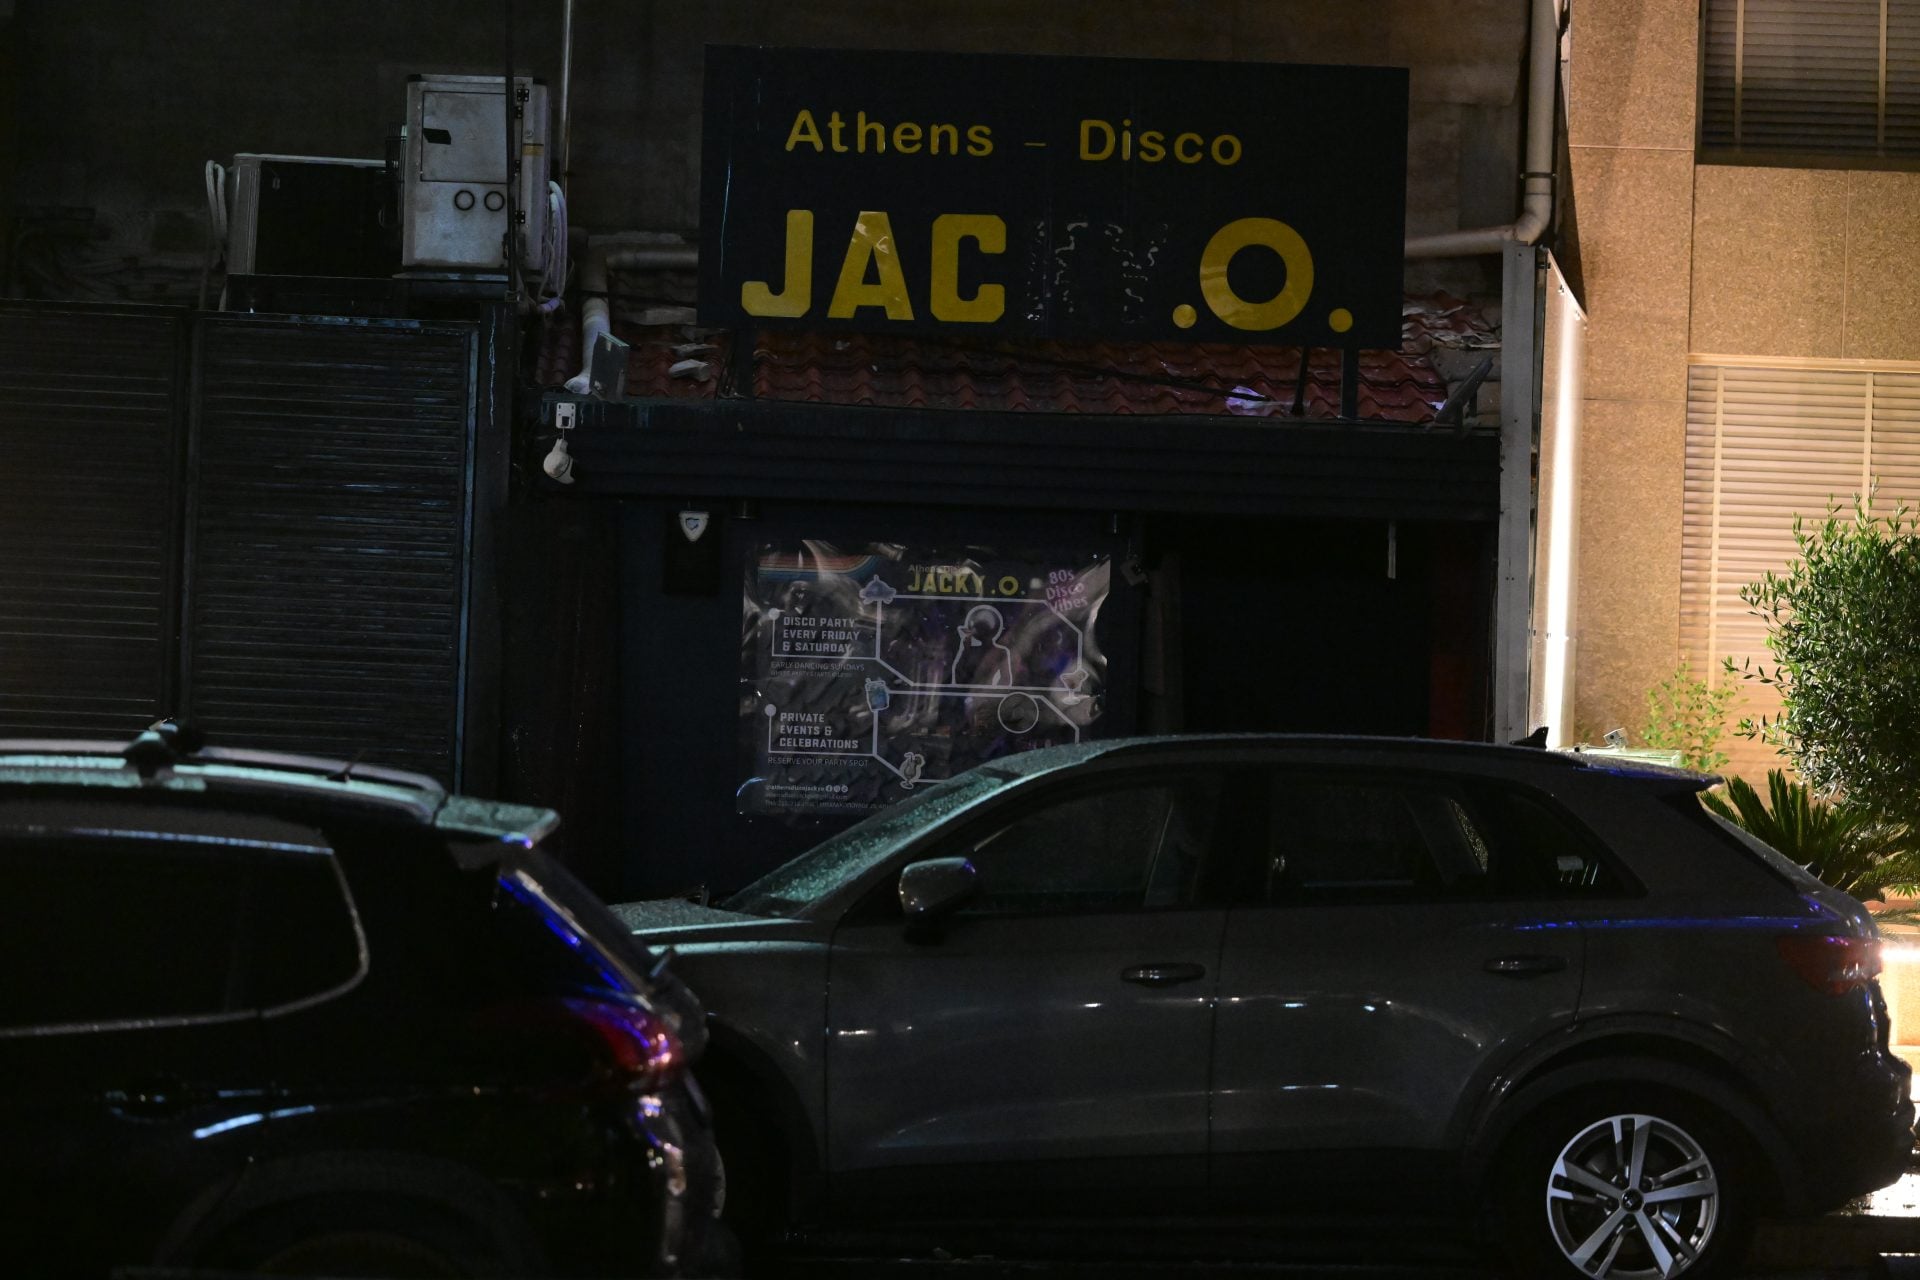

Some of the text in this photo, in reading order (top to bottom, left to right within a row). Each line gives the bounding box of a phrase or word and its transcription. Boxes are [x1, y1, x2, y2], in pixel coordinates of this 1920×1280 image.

[785, 109, 995, 158] Athens
[1079, 117, 1243, 166] Disco
[1048, 569, 1075, 585] 80s
[1045, 581, 1085, 600] Disco
[783, 616, 856, 628] DISCO PARTY
[783, 629, 860, 641] EVERY FRIDAY
[782, 640, 852, 654] & SATURDAY
[780, 712, 825, 723] PRIVATE
[779, 725, 833, 736] EVENTS &
[779, 737, 859, 749] CELEBRATIONS
[767, 756, 869, 767] RESERVE YOUR PARTY SPOT
